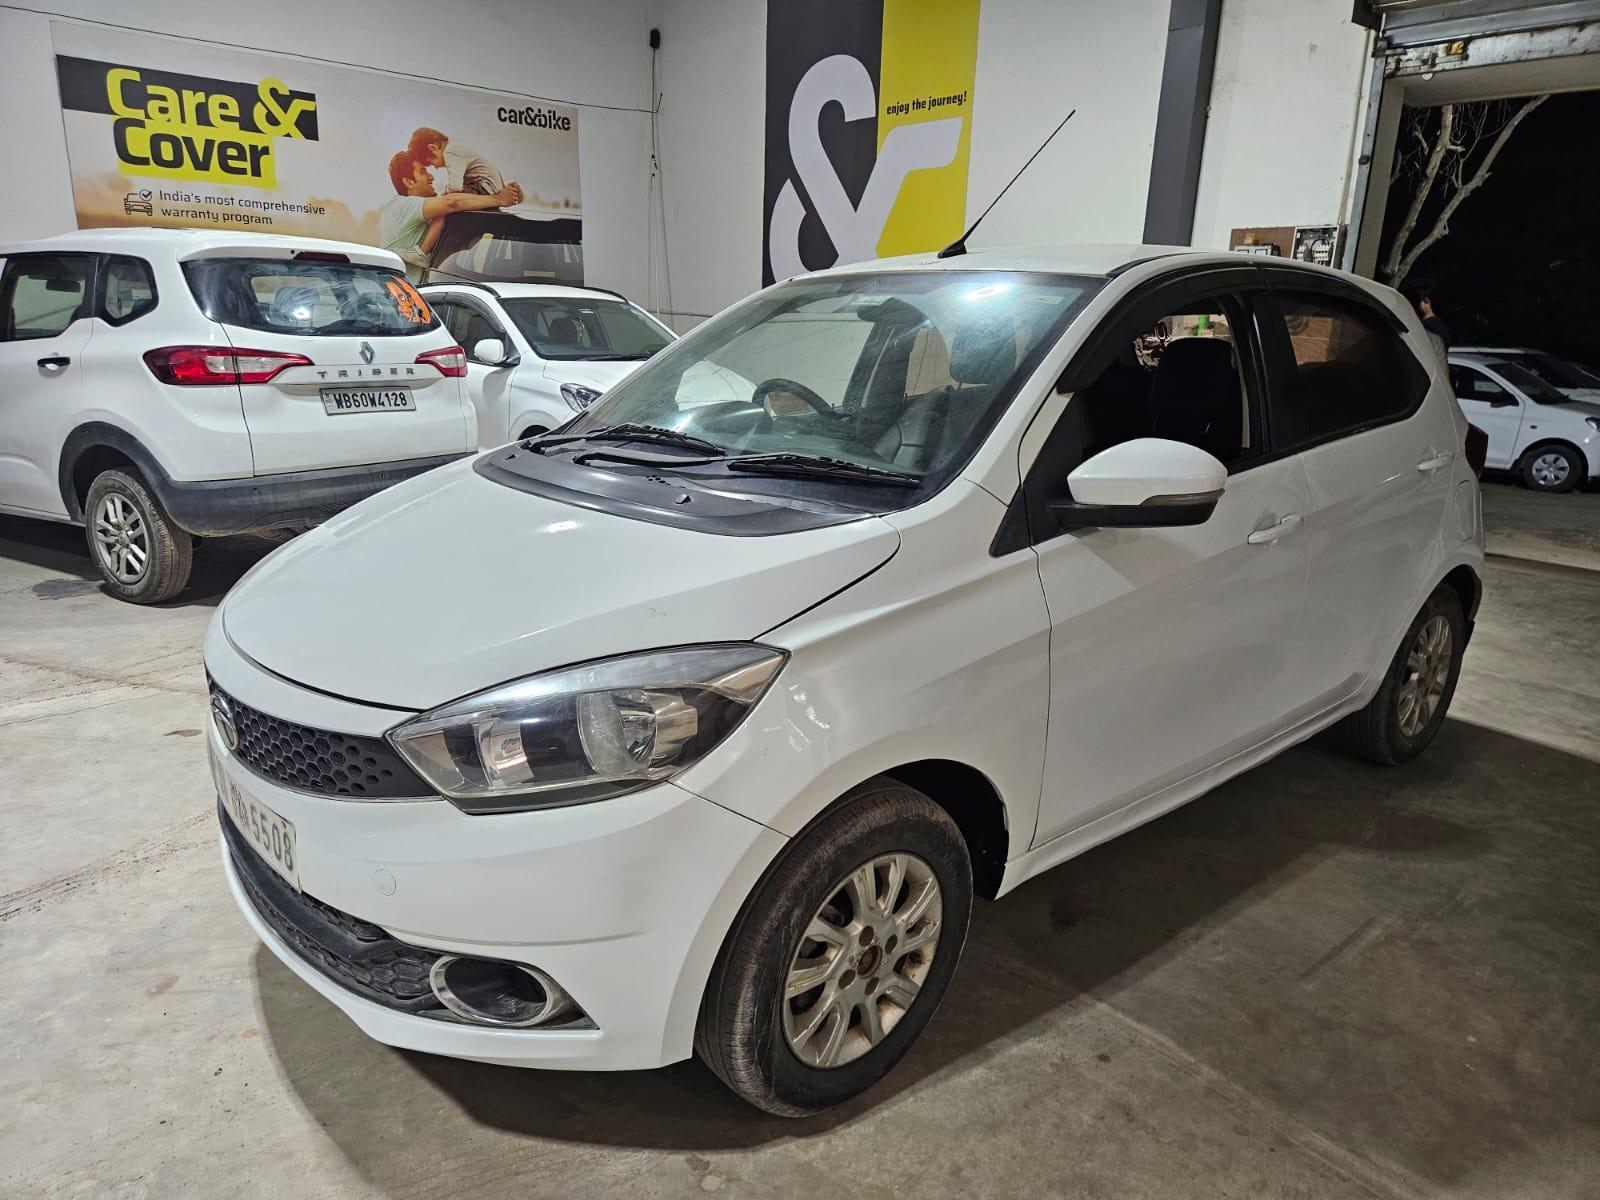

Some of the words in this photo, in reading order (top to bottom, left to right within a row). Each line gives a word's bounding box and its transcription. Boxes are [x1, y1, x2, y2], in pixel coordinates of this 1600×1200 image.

[106, 68, 241, 130] Care
[253, 77, 316, 140] &
[886, 102, 910, 116] enjoy
[912, 97, 927, 111] the
[928, 90, 968, 111] journey!
[497, 106, 571, 131] car&bike
[113, 117, 270, 178] Cover
[159, 190, 202, 204] India's
[205, 196, 235, 206] most
[238, 198, 326, 215] comprehensive
[161, 209, 219, 223] warranty
[222, 211, 273, 225] program
[316, 367, 415, 379] TRIBER
[332, 391, 408, 410] WB60W4128
